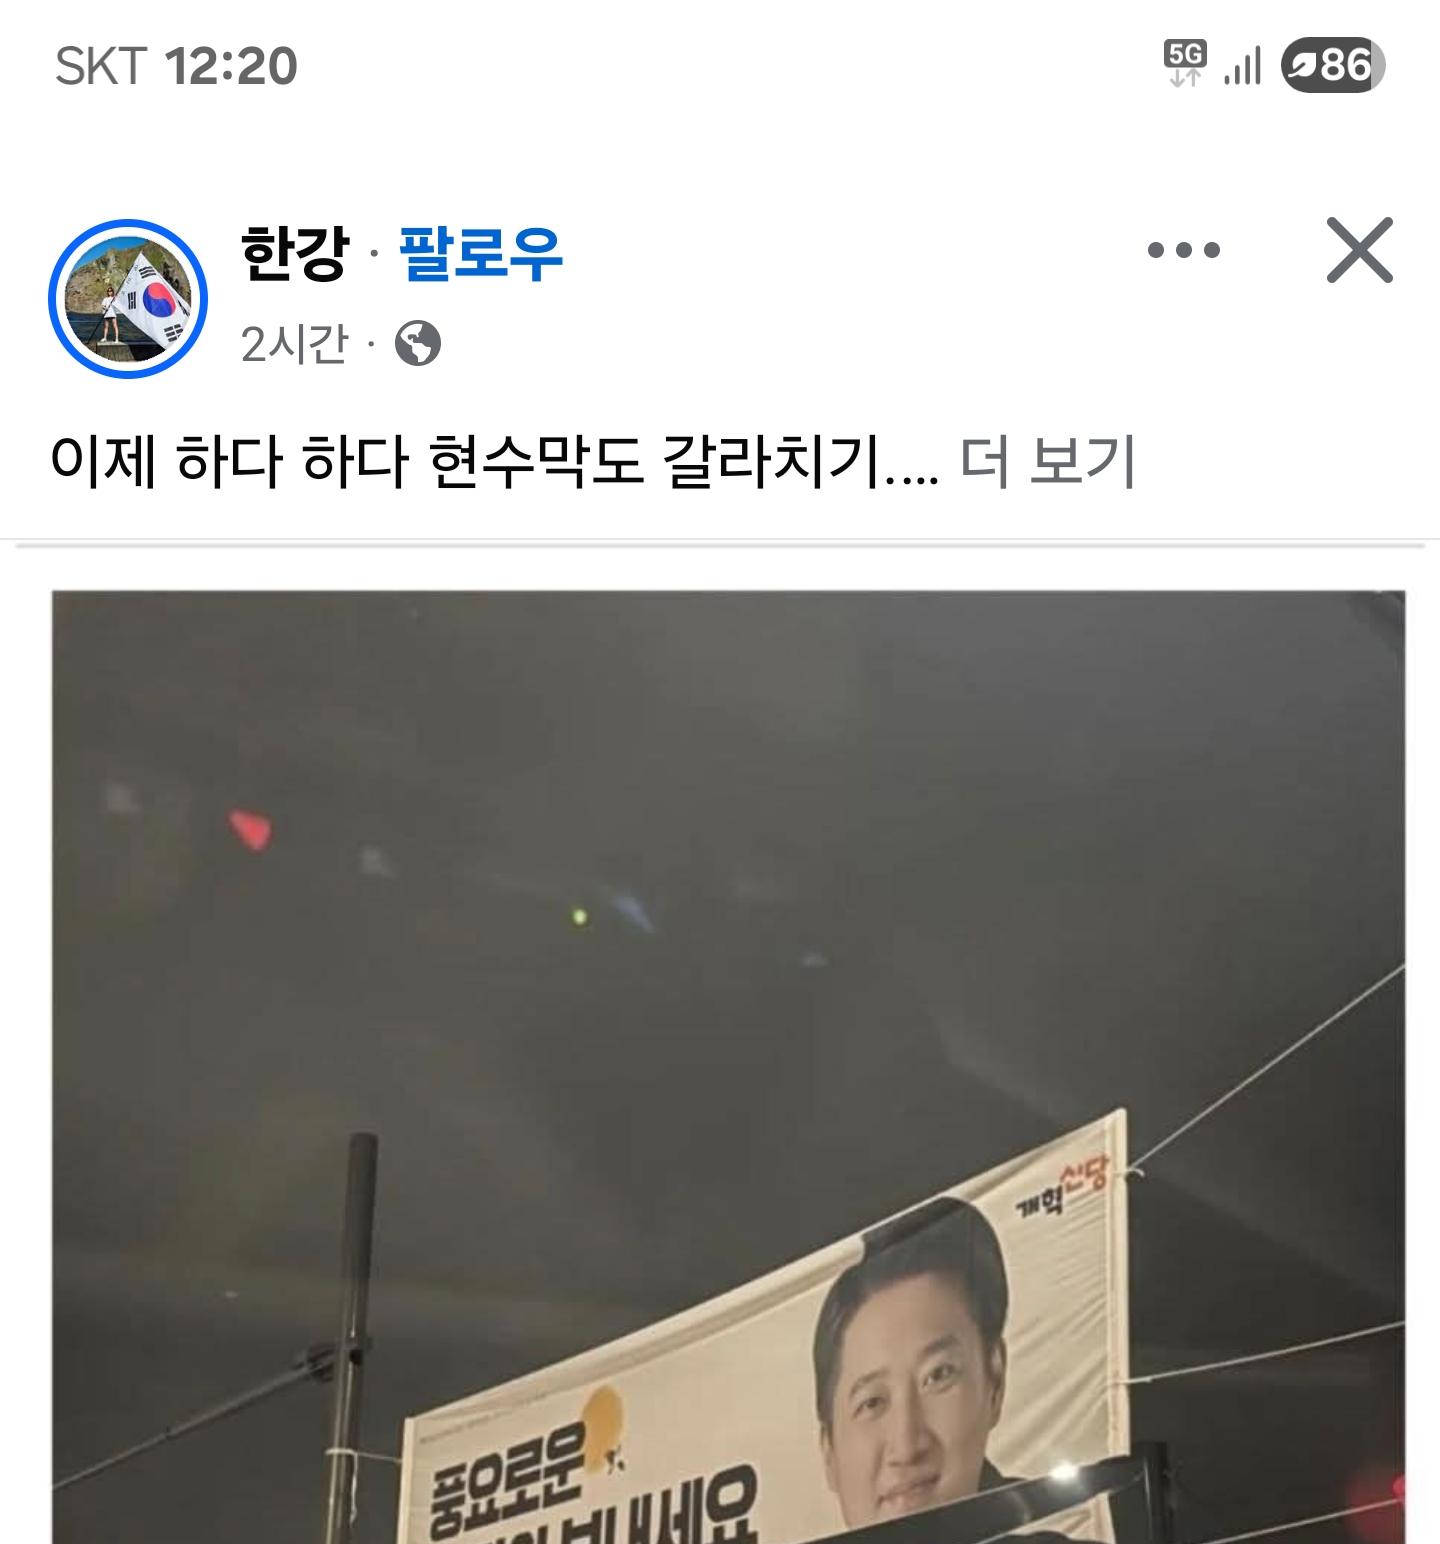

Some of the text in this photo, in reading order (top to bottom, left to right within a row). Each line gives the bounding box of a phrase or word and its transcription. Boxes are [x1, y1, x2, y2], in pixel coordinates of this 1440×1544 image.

[56, 46, 297, 85] SKT 12:20
[1168, 42, 1203, 65] 5G
[1320, 46, 1372, 82] 86
[242, 226, 563, 282] 한강 팔로우
[242, 324, 349, 365] 2시간
[52, 434, 153, 489] 이제
[176, 434, 283, 489] 하다
[302, 434, 409, 489] 하다
[430, 434, 644, 489] 현수막도
[963, 435, 1006, 489] 더
[1031, 435, 1132, 489] 보기
[1015, 1154, 1110, 1218] 개혁신당
[430, 1421, 587, 1542] 풍요로운
